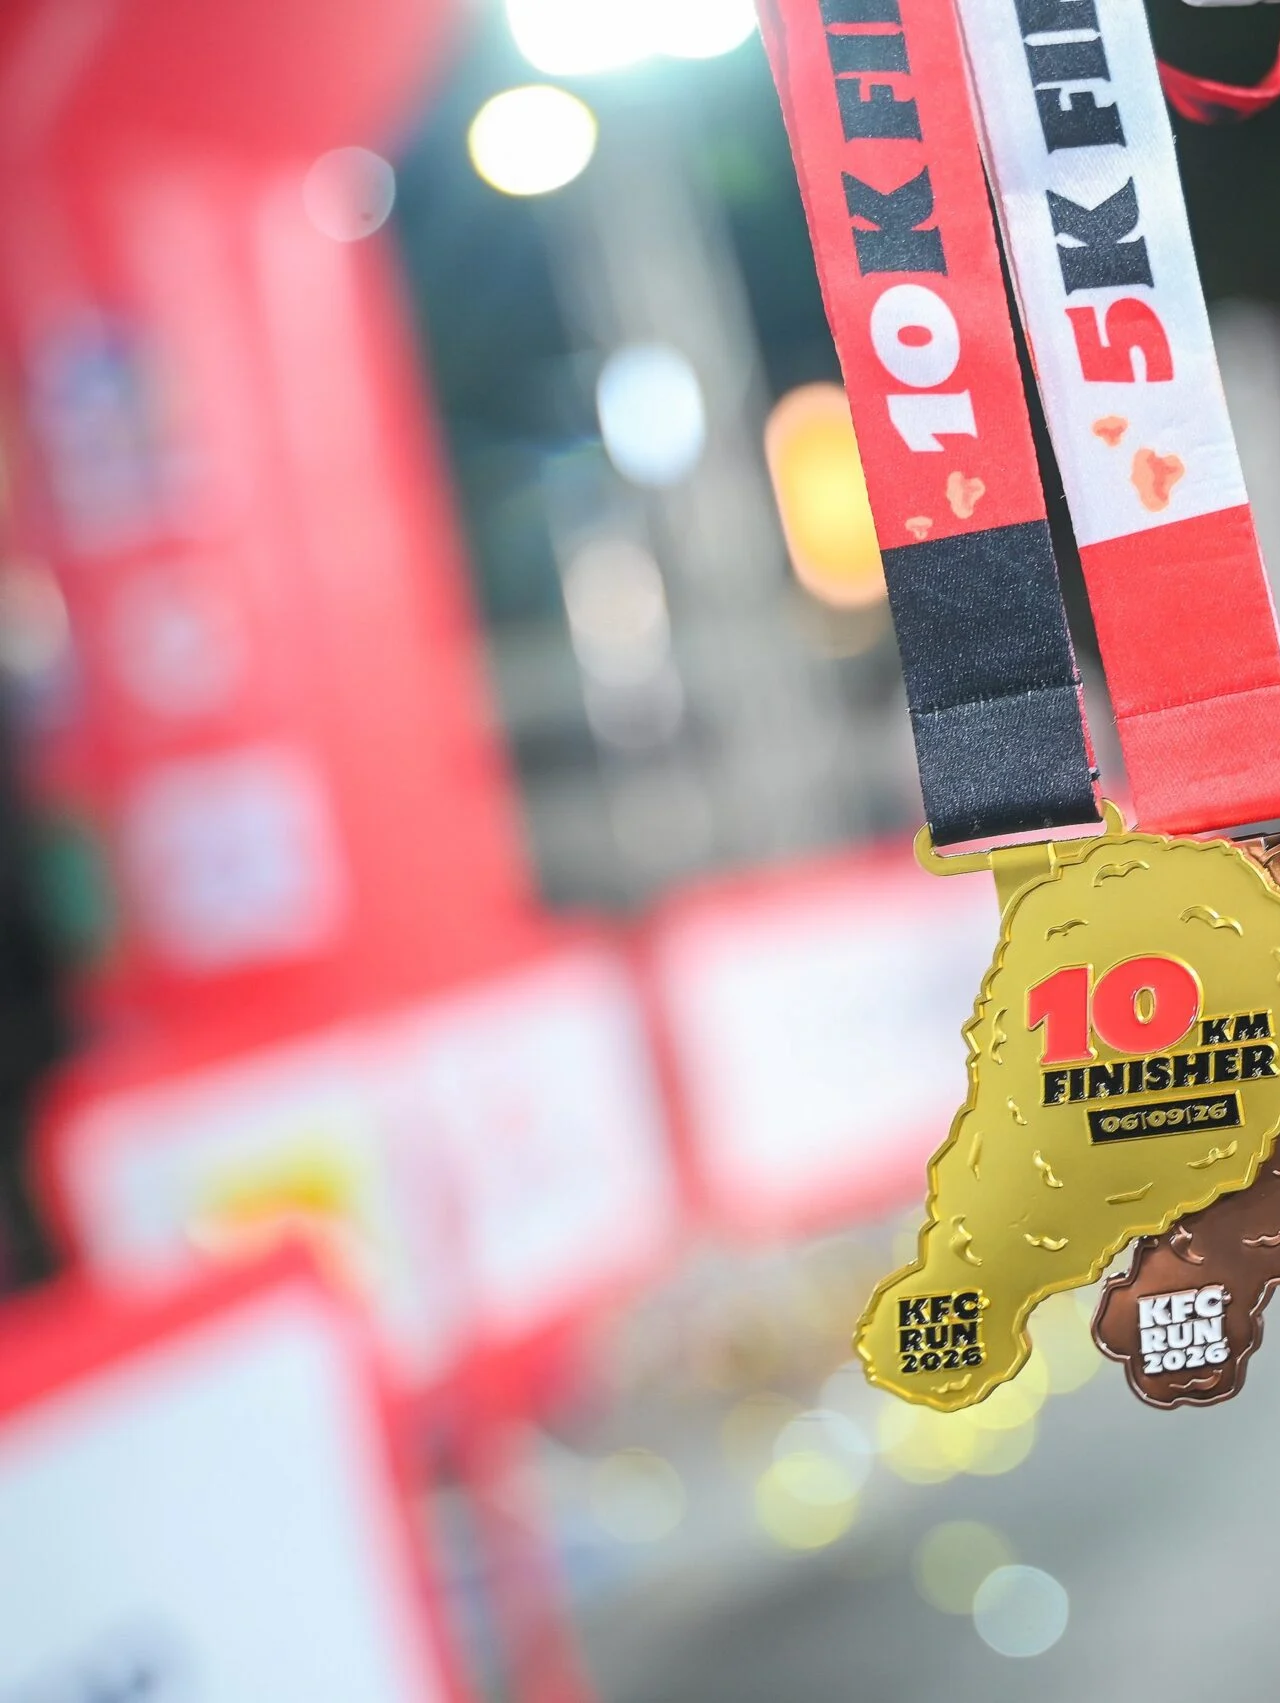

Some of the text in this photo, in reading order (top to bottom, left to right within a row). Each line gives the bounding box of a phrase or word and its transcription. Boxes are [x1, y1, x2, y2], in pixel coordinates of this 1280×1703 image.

[1046, 176, 1174, 383] 5K
[1025, 953, 1273, 1064] 10 KM
[1041, 1044, 1280, 1106] FINISHER
[898, 1291, 980, 1327] KFC
[1138, 1286, 1225, 1328] KFC
[898, 1320, 980, 1354] RUN
[1140, 1316, 1225, 1355] RUN
[901, 1346, 984, 1374] 2026
[1143, 1341, 1229, 1375] 2026
